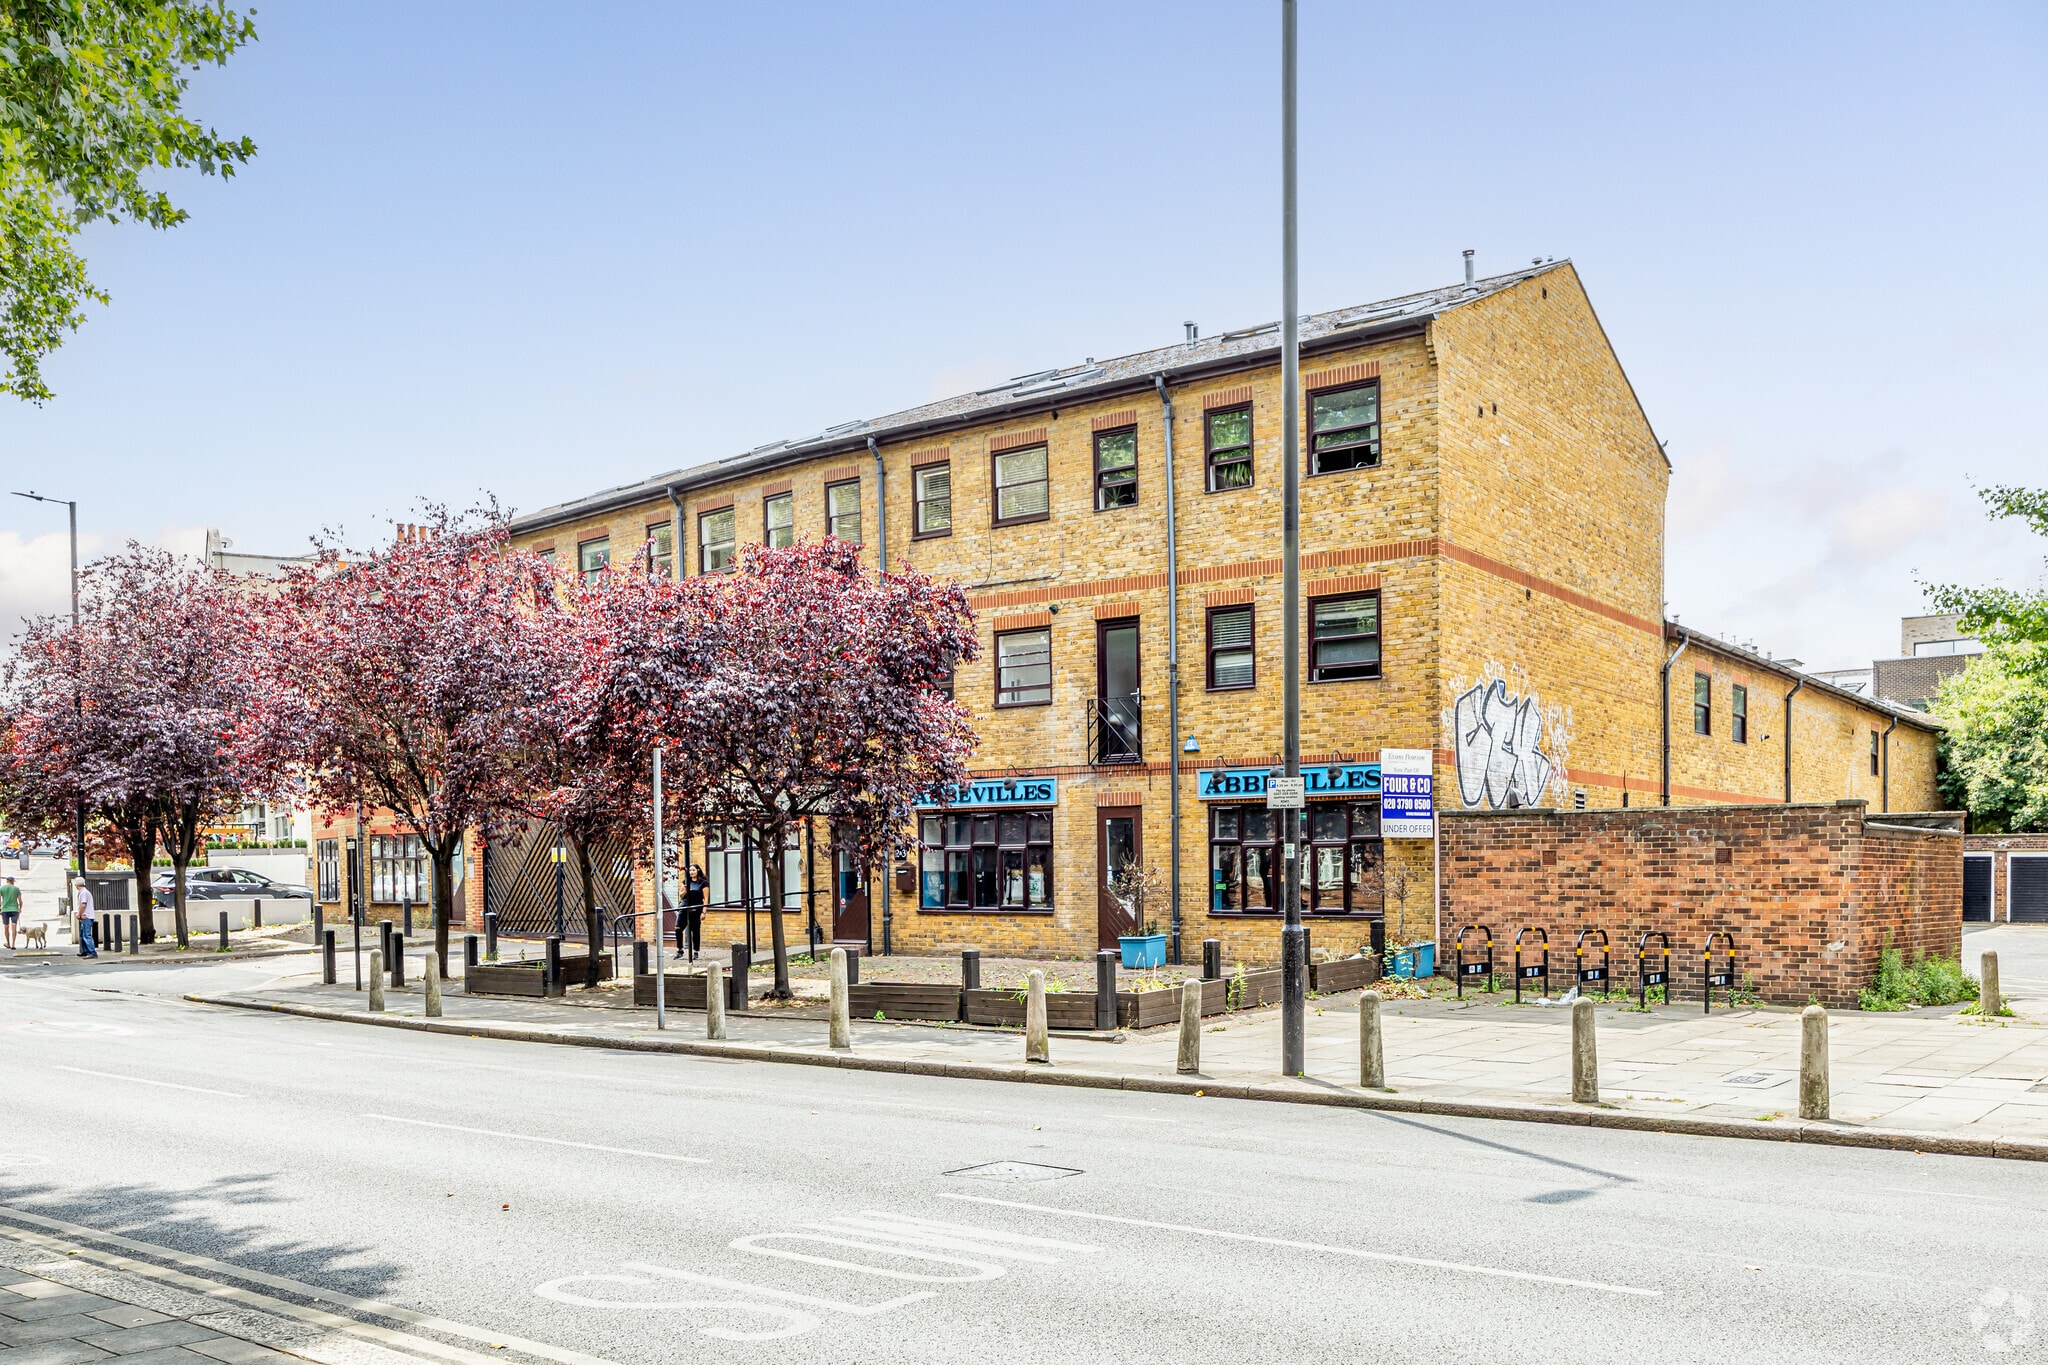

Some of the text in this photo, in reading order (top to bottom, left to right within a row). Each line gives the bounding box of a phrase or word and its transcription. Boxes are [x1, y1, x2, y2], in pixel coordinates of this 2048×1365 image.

[1384, 776, 1409, 793] FOUR
[1409, 777, 1416, 793] &
[1384, 798, 1431, 810] 020 3790 8500
[1384, 824, 1432, 833] UNDER OFFER
